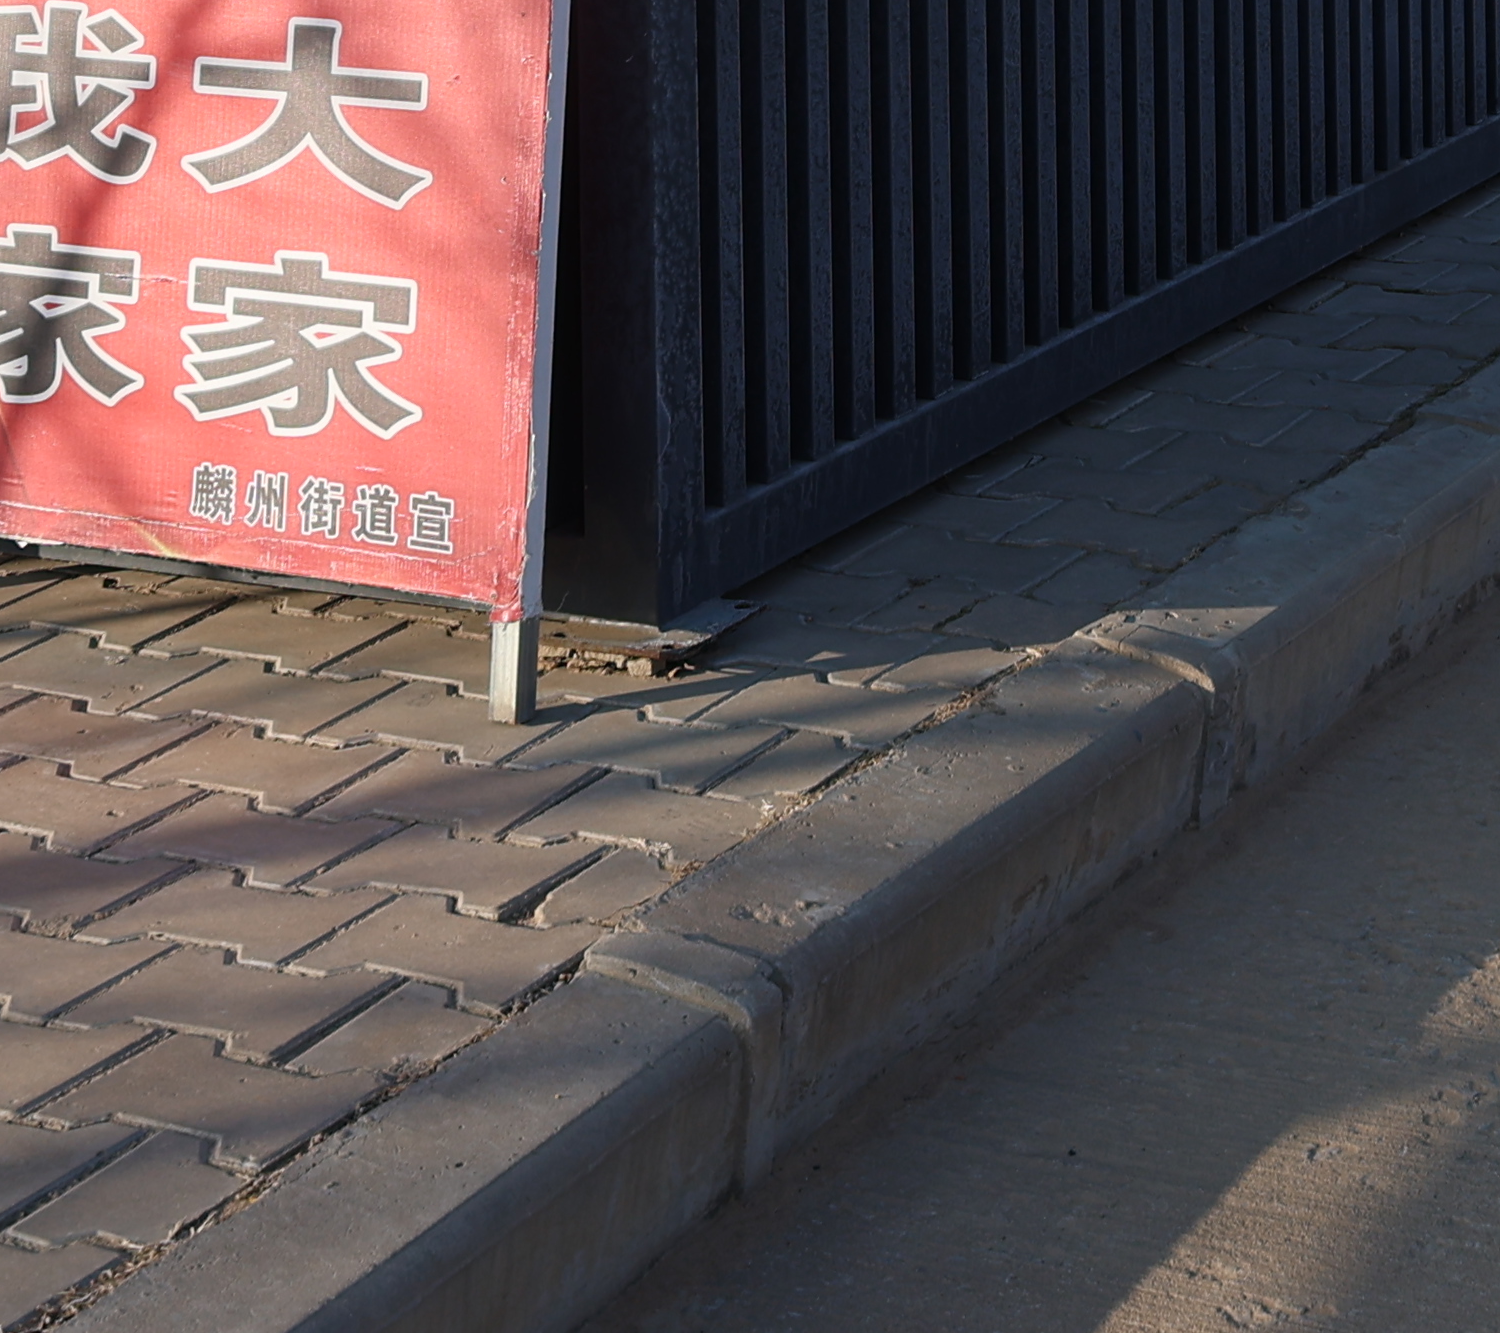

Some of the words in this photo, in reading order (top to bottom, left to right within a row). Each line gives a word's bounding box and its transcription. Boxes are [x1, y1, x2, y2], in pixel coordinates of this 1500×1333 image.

[190, 462, 454, 554] 麟州街道宣
